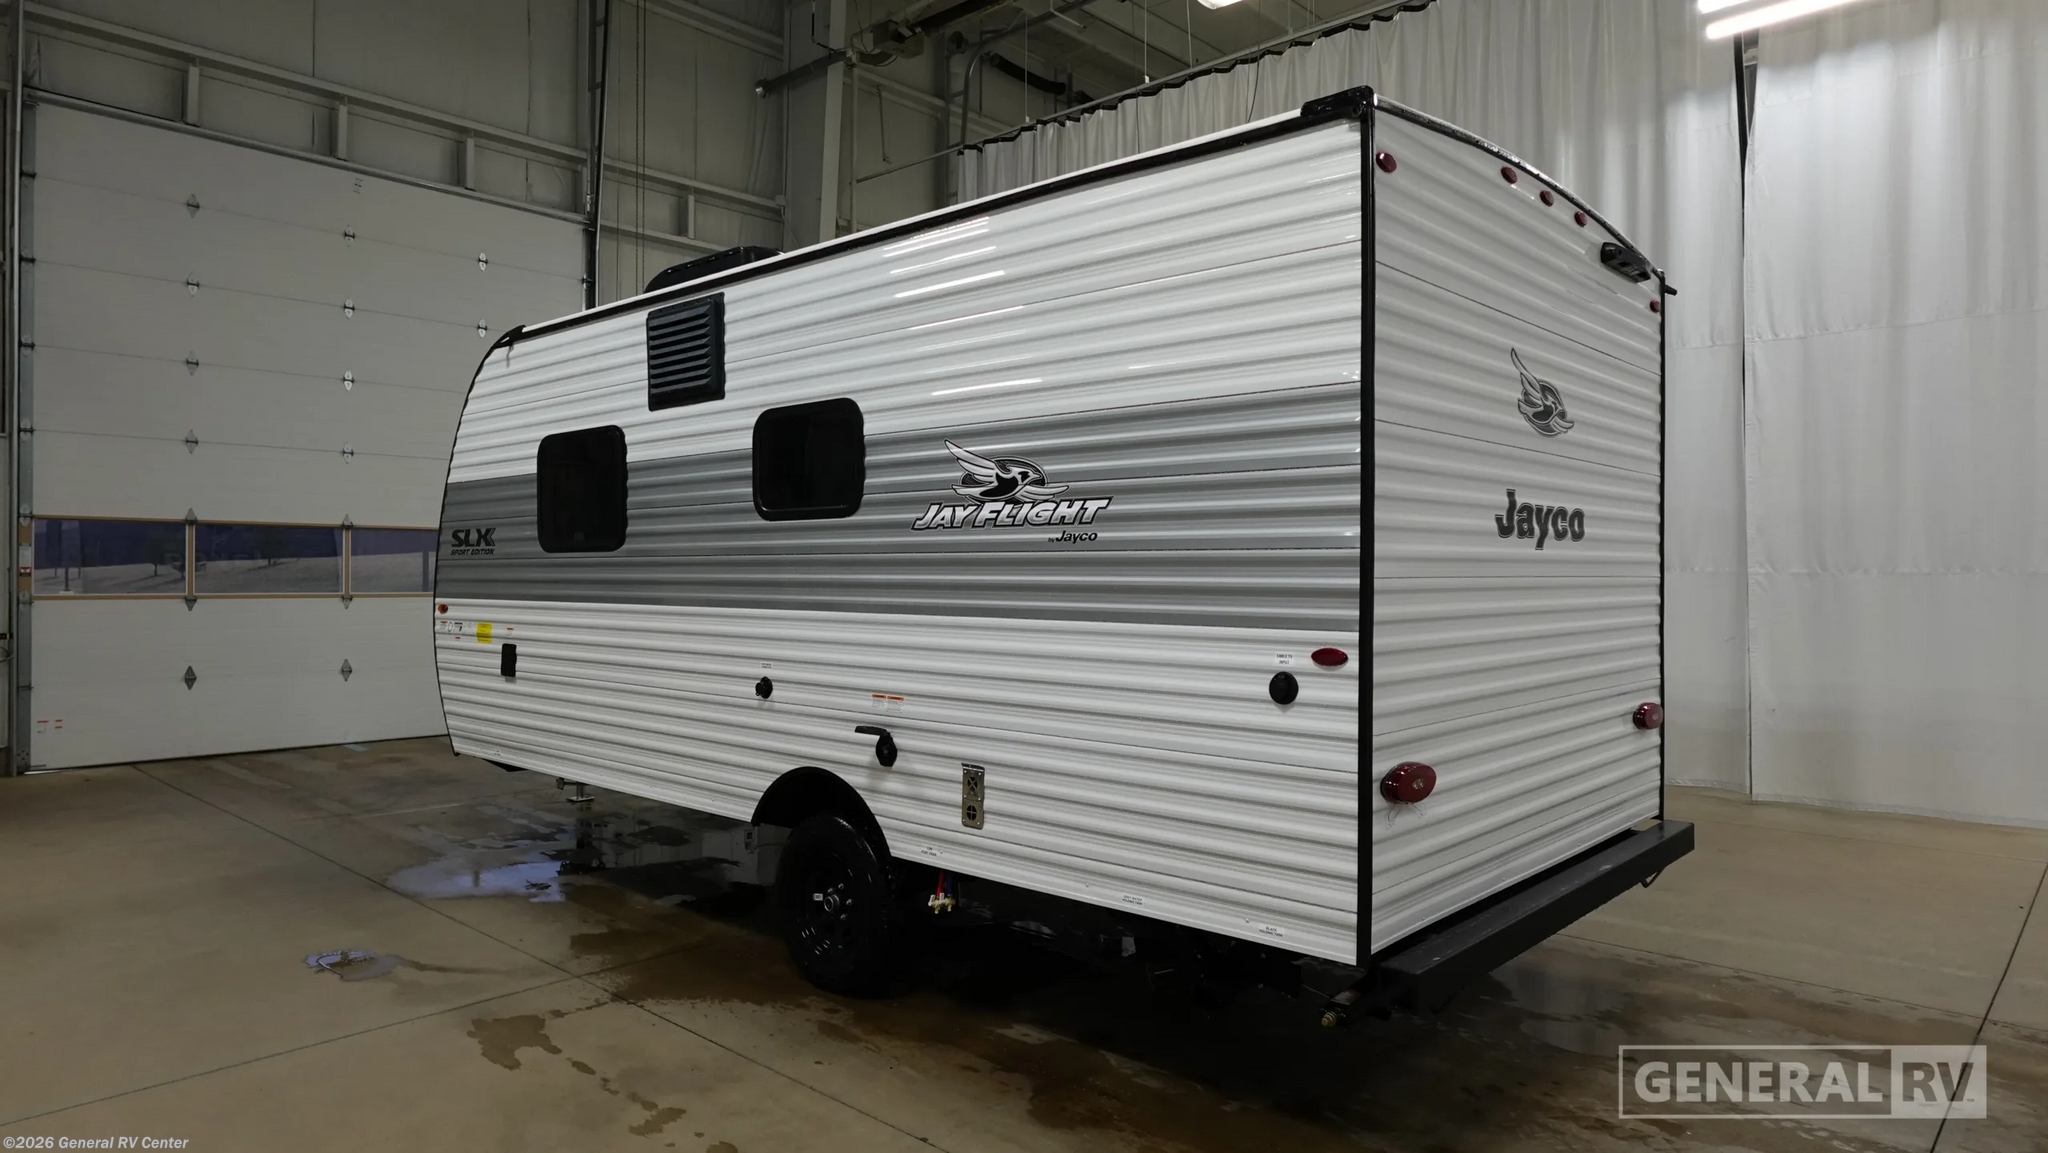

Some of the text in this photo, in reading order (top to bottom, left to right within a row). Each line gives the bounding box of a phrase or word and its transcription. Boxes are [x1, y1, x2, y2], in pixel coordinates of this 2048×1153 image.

[910, 496, 1115, 531] JAY FLIGHT
[1495, 488, 1585, 550] Jayco
[451, 527, 497, 547] SLK
[1055, 530, 1098, 545] Jayco
